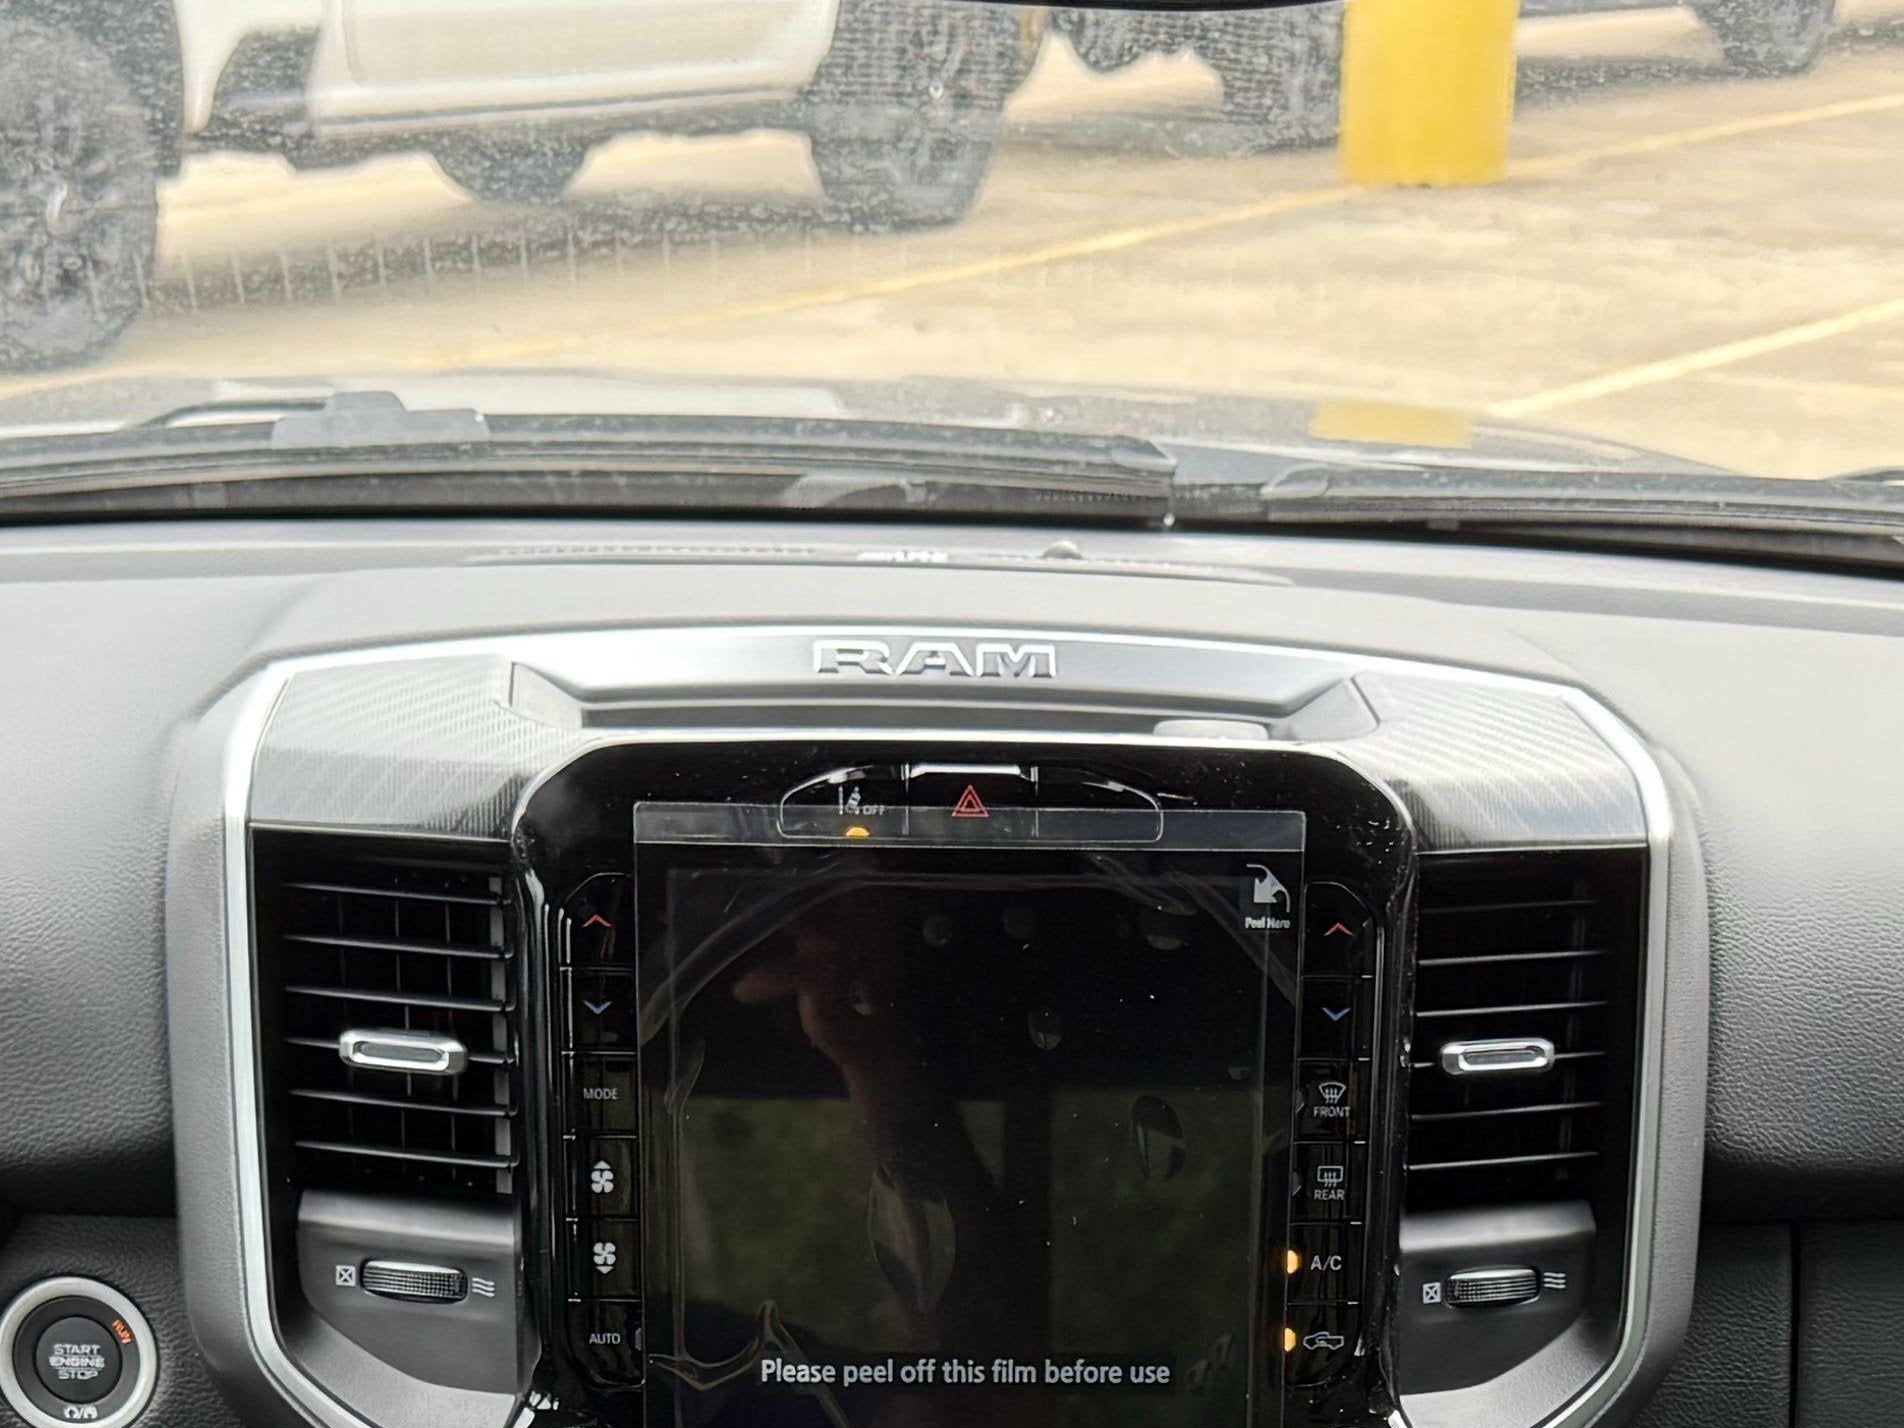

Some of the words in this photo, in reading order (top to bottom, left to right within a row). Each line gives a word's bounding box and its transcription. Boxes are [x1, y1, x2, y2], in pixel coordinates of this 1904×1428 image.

[813, 640, 1057, 678] RAM
[583, 1087, 619, 1100] MODE
[1313, 1106, 1351, 1118] FRONT
[1314, 1189, 1345, 1201] REAR
[1310, 1256, 1343, 1271] A/C
[589, 1333, 621, 1345] AUTO
[54, 1344, 100, 1355] START
[49, 1356, 104, 1368] ENGINE
[58, 1369, 98, 1380] STOP
[761, 1359, 836, 1384] Please
[843, 1359, 894, 1387] peel
[900, 1358, 936, 1384] off
[942, 1359, 985, 1384] this
[992, 1358, 1037, 1384] film
[1044, 1358, 1122, 1384] before
[1130, 1365, 1170, 1385] use
